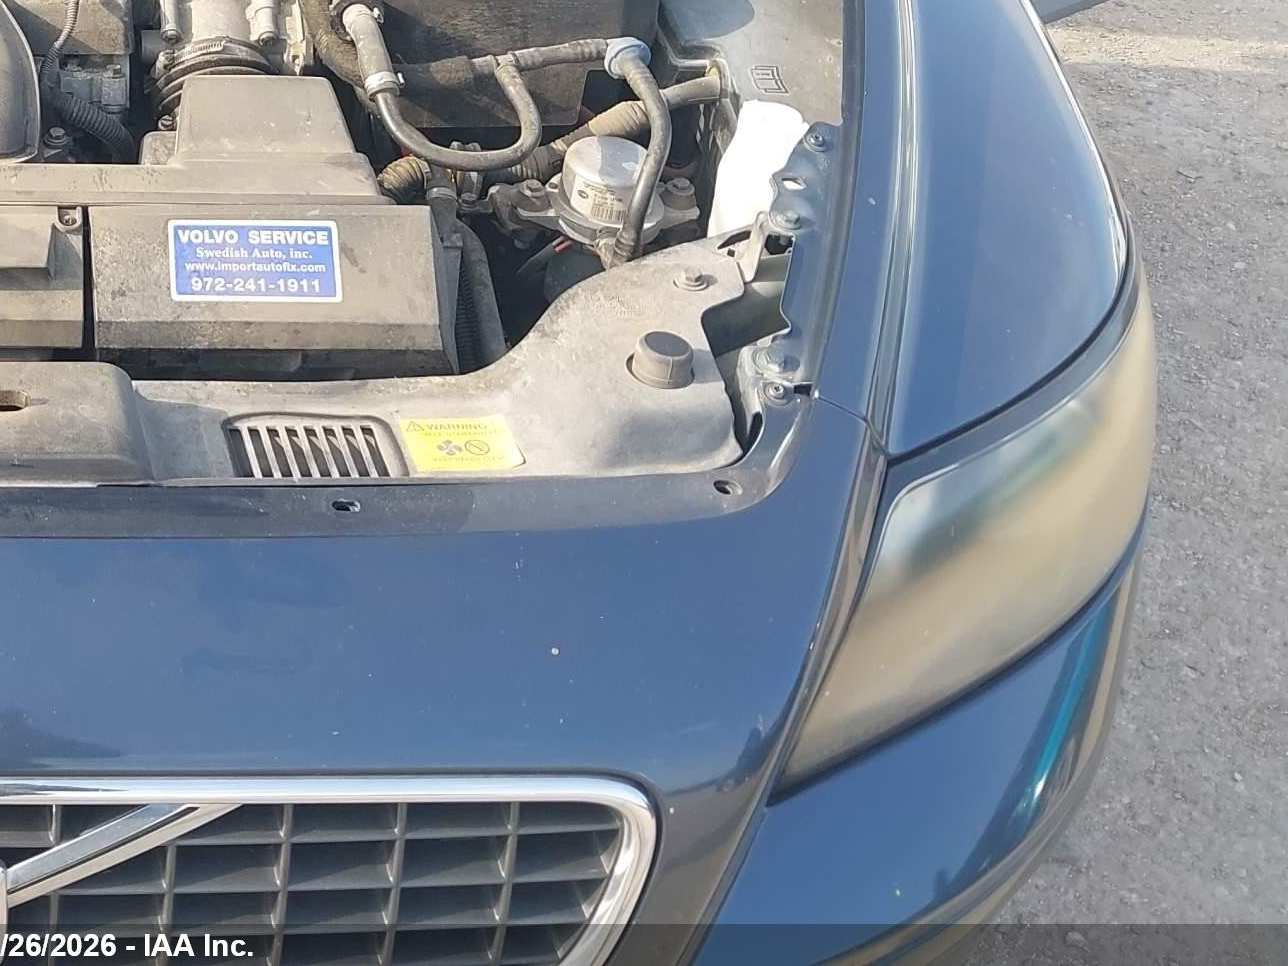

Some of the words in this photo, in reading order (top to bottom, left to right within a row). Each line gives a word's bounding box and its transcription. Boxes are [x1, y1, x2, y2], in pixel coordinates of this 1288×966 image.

[177, 229, 239, 244] VOLVO
[248, 230, 329, 245] SERVICE
[196, 246, 248, 258] Swedish
[251, 248, 287, 260] Auto,
[289, 247, 313, 259] inc.
[184, 260, 326, 273] www.importautofix.com
[191, 277, 320, 292] 972-241-1911
